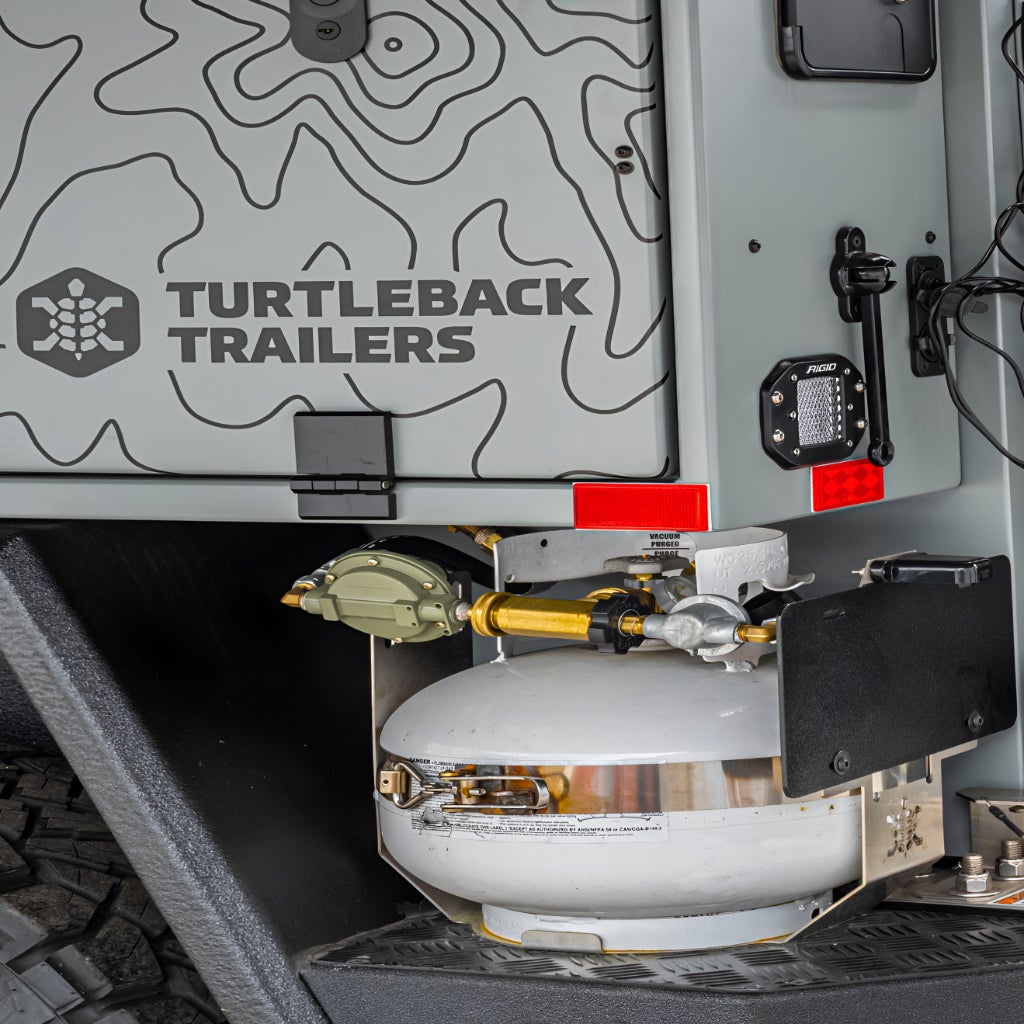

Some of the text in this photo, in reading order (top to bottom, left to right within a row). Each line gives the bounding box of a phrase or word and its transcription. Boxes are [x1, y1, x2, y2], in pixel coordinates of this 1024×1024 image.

[166, 277, 593, 318] TURTLEBACK
[167, 326, 476, 364] TRAILERS
[806, 363, 837, 374] RIGID
